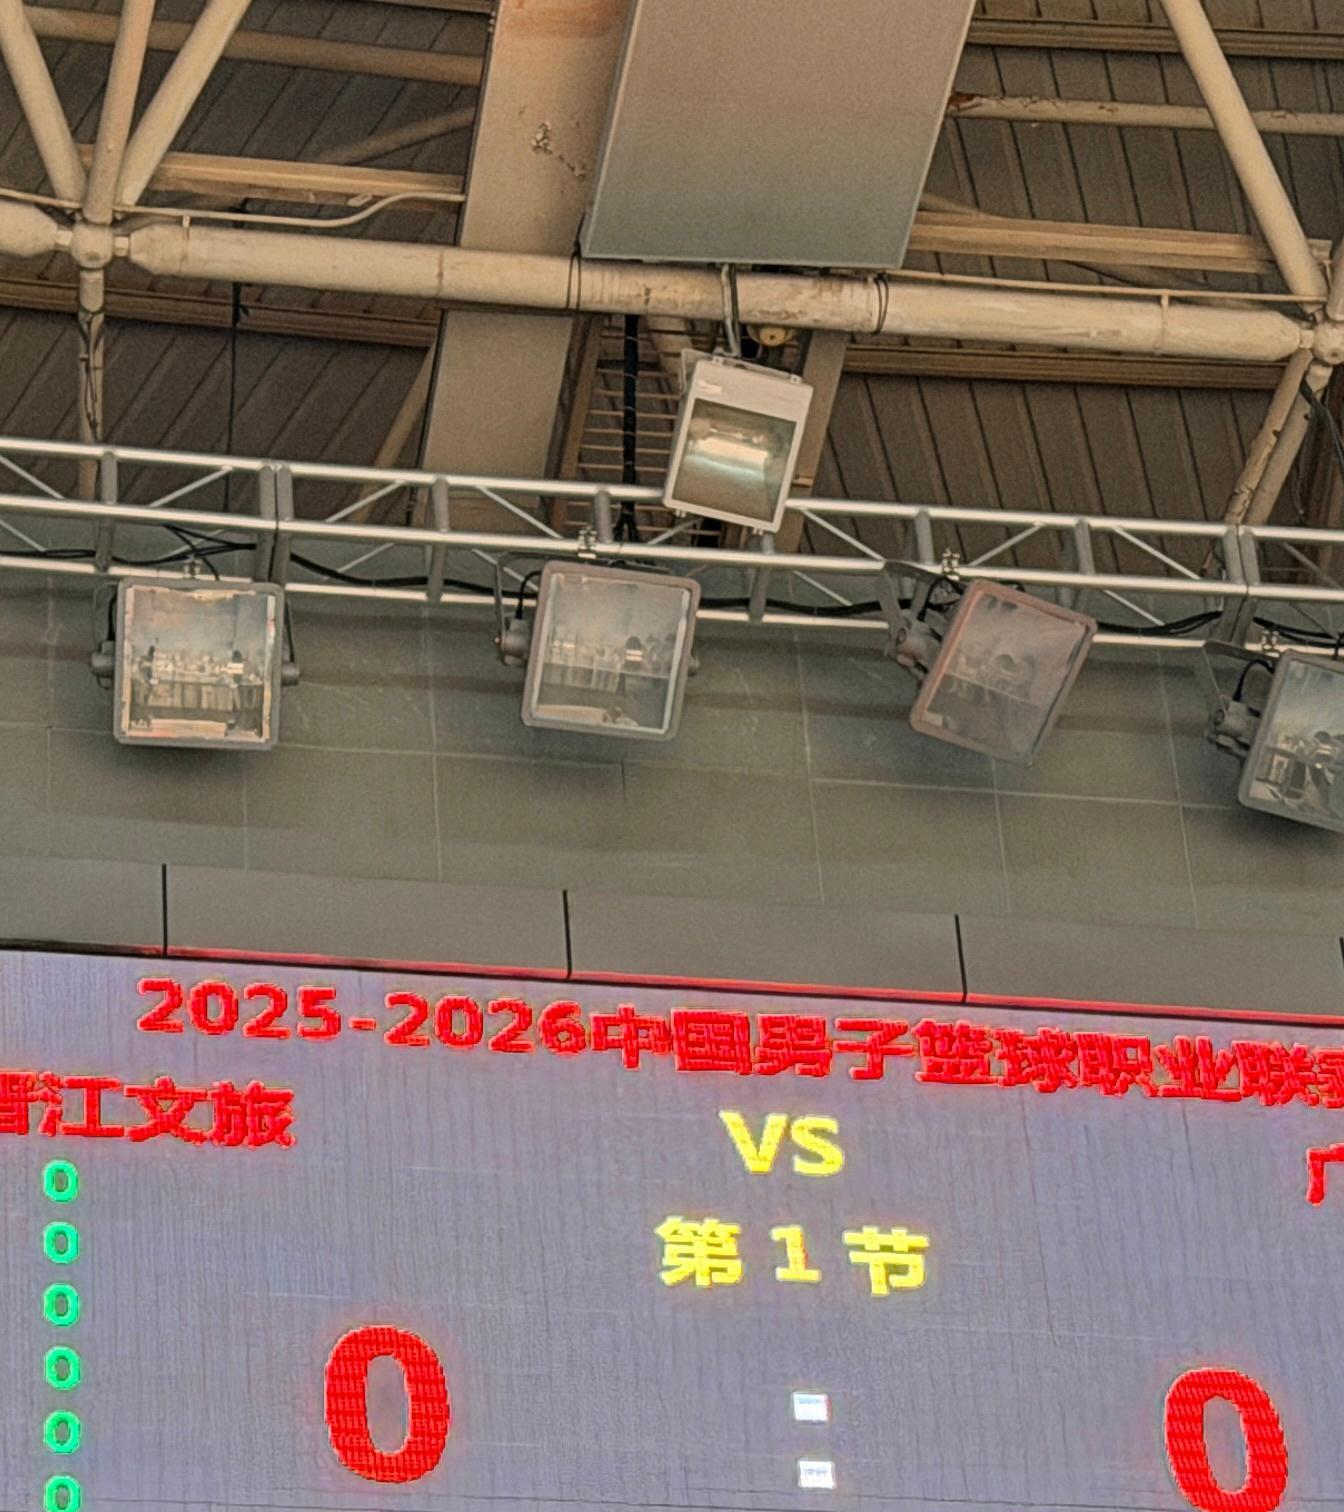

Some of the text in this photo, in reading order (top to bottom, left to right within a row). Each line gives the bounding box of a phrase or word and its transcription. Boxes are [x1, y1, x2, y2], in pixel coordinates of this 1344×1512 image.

[719, 1110, 845, 1177] VS
[42, 1160, 81, 1205] 0
[42, 1222, 81, 1266] 0
[42, 1281, 83, 1329] 0
[43, 1345, 84, 1393] 0
[324, 1325, 453, 1485] 0
[42, 1408, 84, 1456] 0
